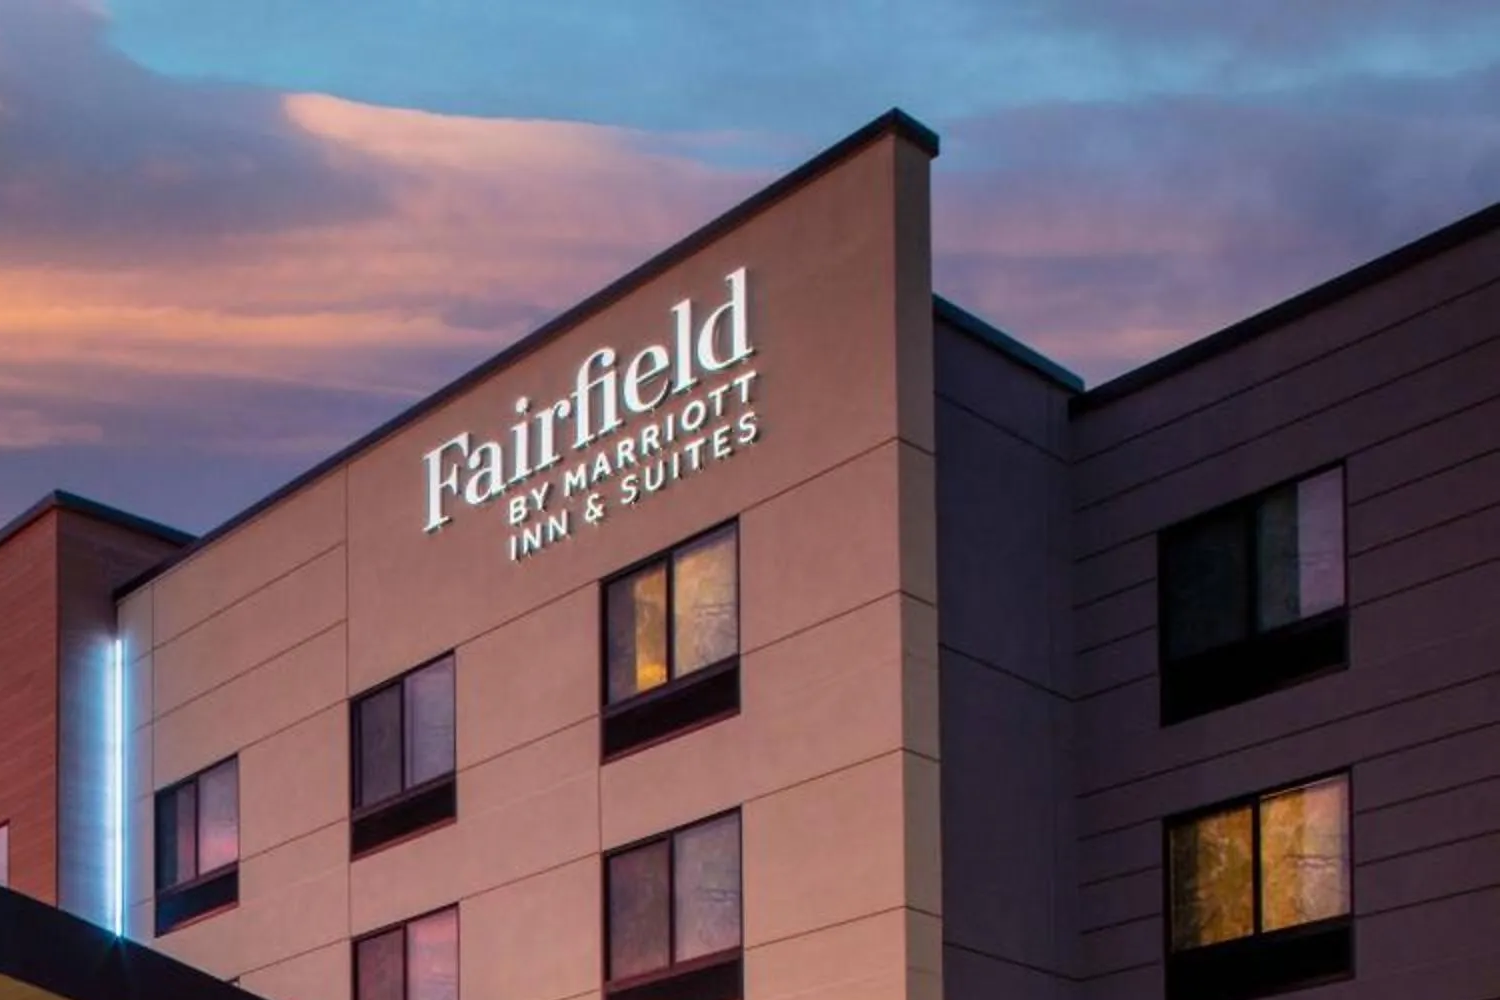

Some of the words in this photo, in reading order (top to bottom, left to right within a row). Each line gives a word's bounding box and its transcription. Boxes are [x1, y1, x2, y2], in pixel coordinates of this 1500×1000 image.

[422, 267, 754, 532] Fairfield
[508, 482, 551, 526] BY
[564, 371, 757, 497] MARRIOTT
[510, 509, 569, 562] INN
[585, 493, 605, 524] &
[620, 411, 758, 505] SUITES
